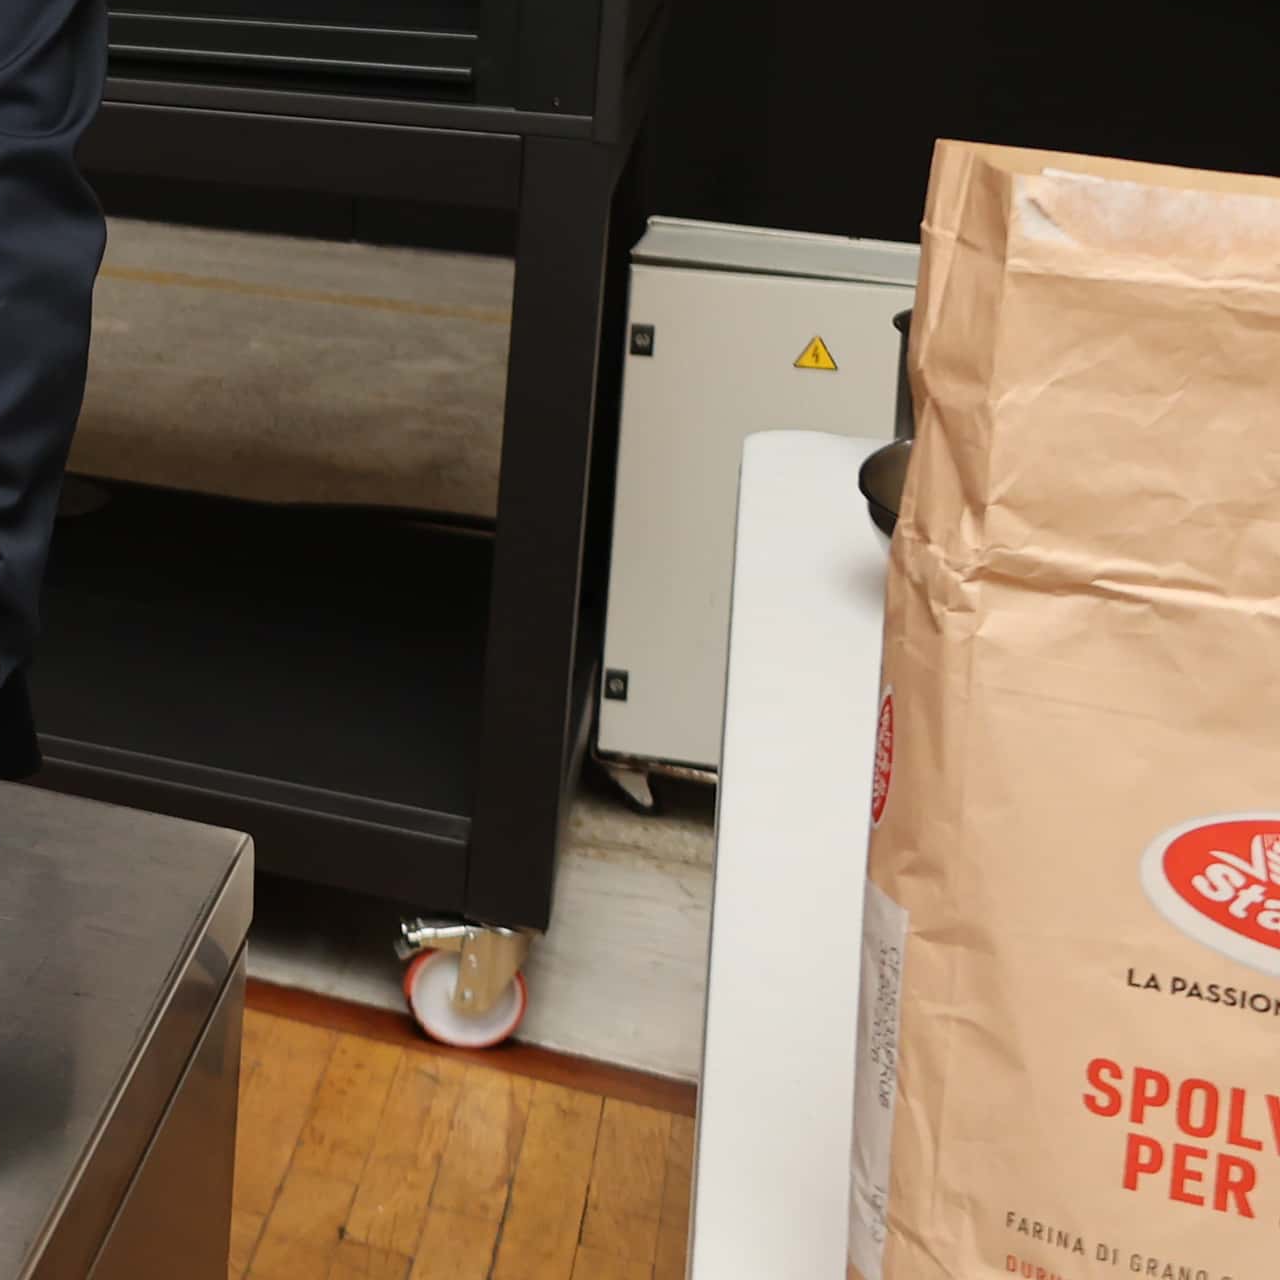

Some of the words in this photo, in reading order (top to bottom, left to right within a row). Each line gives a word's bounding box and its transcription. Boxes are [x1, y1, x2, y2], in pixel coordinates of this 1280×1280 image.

[1127, 968, 1161, 992] LA
[1123, 1133, 1255, 1219] PER
[1005, 1211, 1085, 1256] FARINA
[1096, 1243, 1120, 1265] DI
[1130, 1254, 1209, 1280] GRANO
